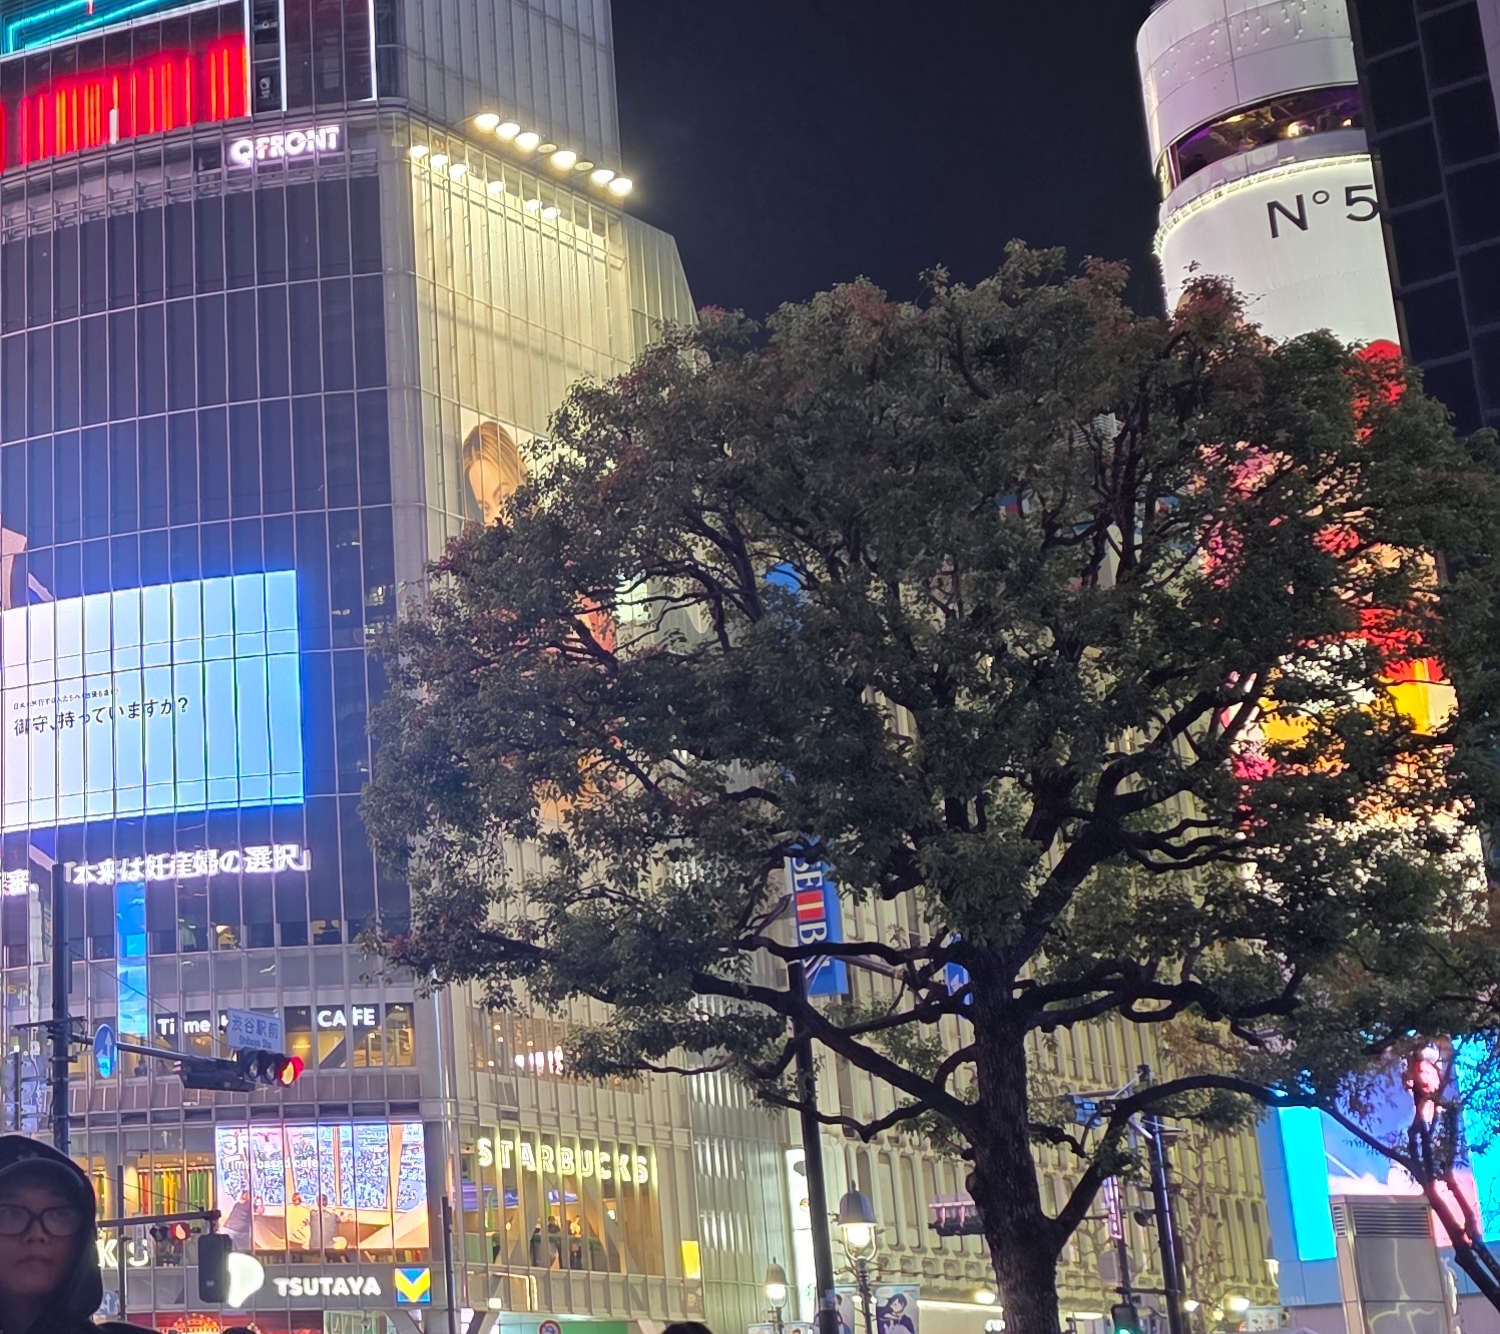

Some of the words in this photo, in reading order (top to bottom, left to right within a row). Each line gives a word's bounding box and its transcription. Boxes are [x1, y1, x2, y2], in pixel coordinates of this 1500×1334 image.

[230, 126, 340, 166] QFRONT
[317, 1006, 376, 1028] CAFE
[477, 1137, 649, 1184] STARBUCKS
[273, 1275, 382, 1298] TSUTAYA
